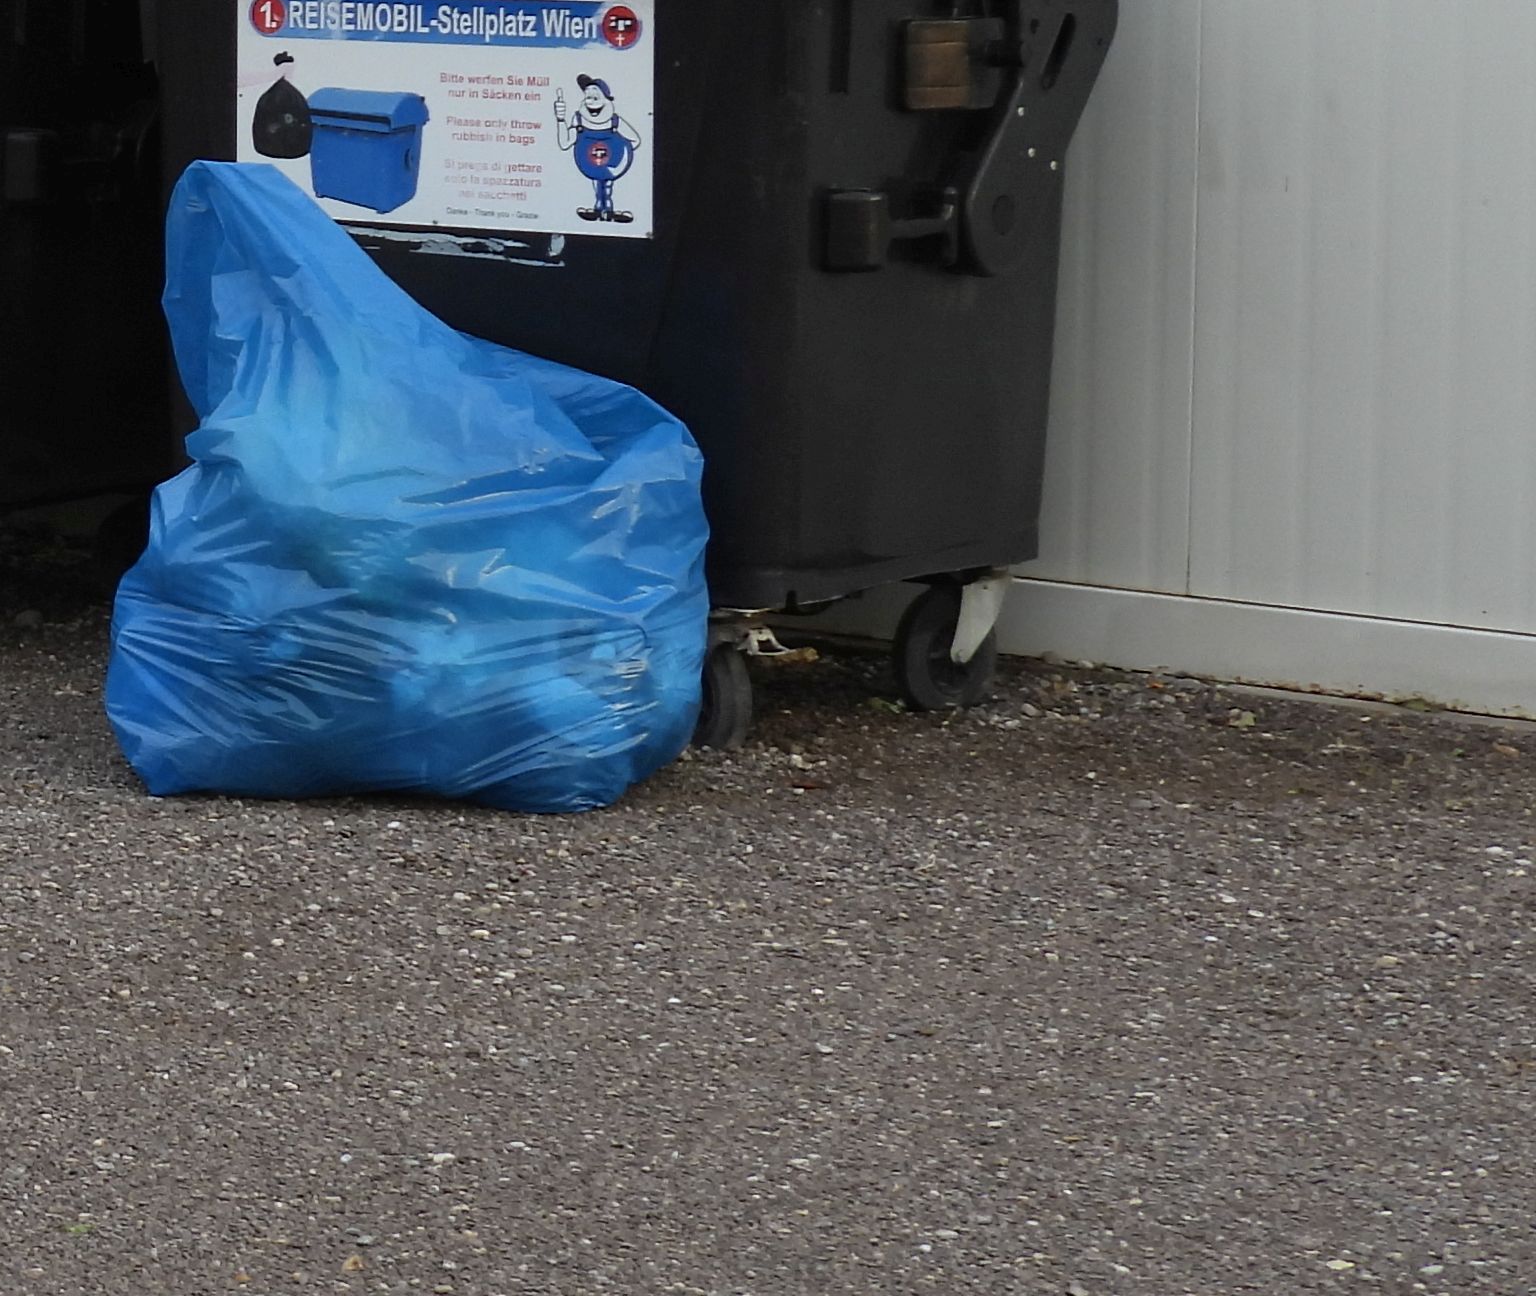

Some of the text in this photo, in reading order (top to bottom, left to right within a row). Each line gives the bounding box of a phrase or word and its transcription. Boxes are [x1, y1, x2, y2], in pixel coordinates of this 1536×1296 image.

[288, 1, 536, 42] REISEMOBIL-Stellplatz
[543, 8, 597, 38] Wien
[440, 72, 550, 87] Bitte werfen Sie Müll
[469, 88, 478, 98] in
[524, 91, 541, 101] ein
[511, 118, 542, 130] throw
[509, 133, 535, 146] bags
